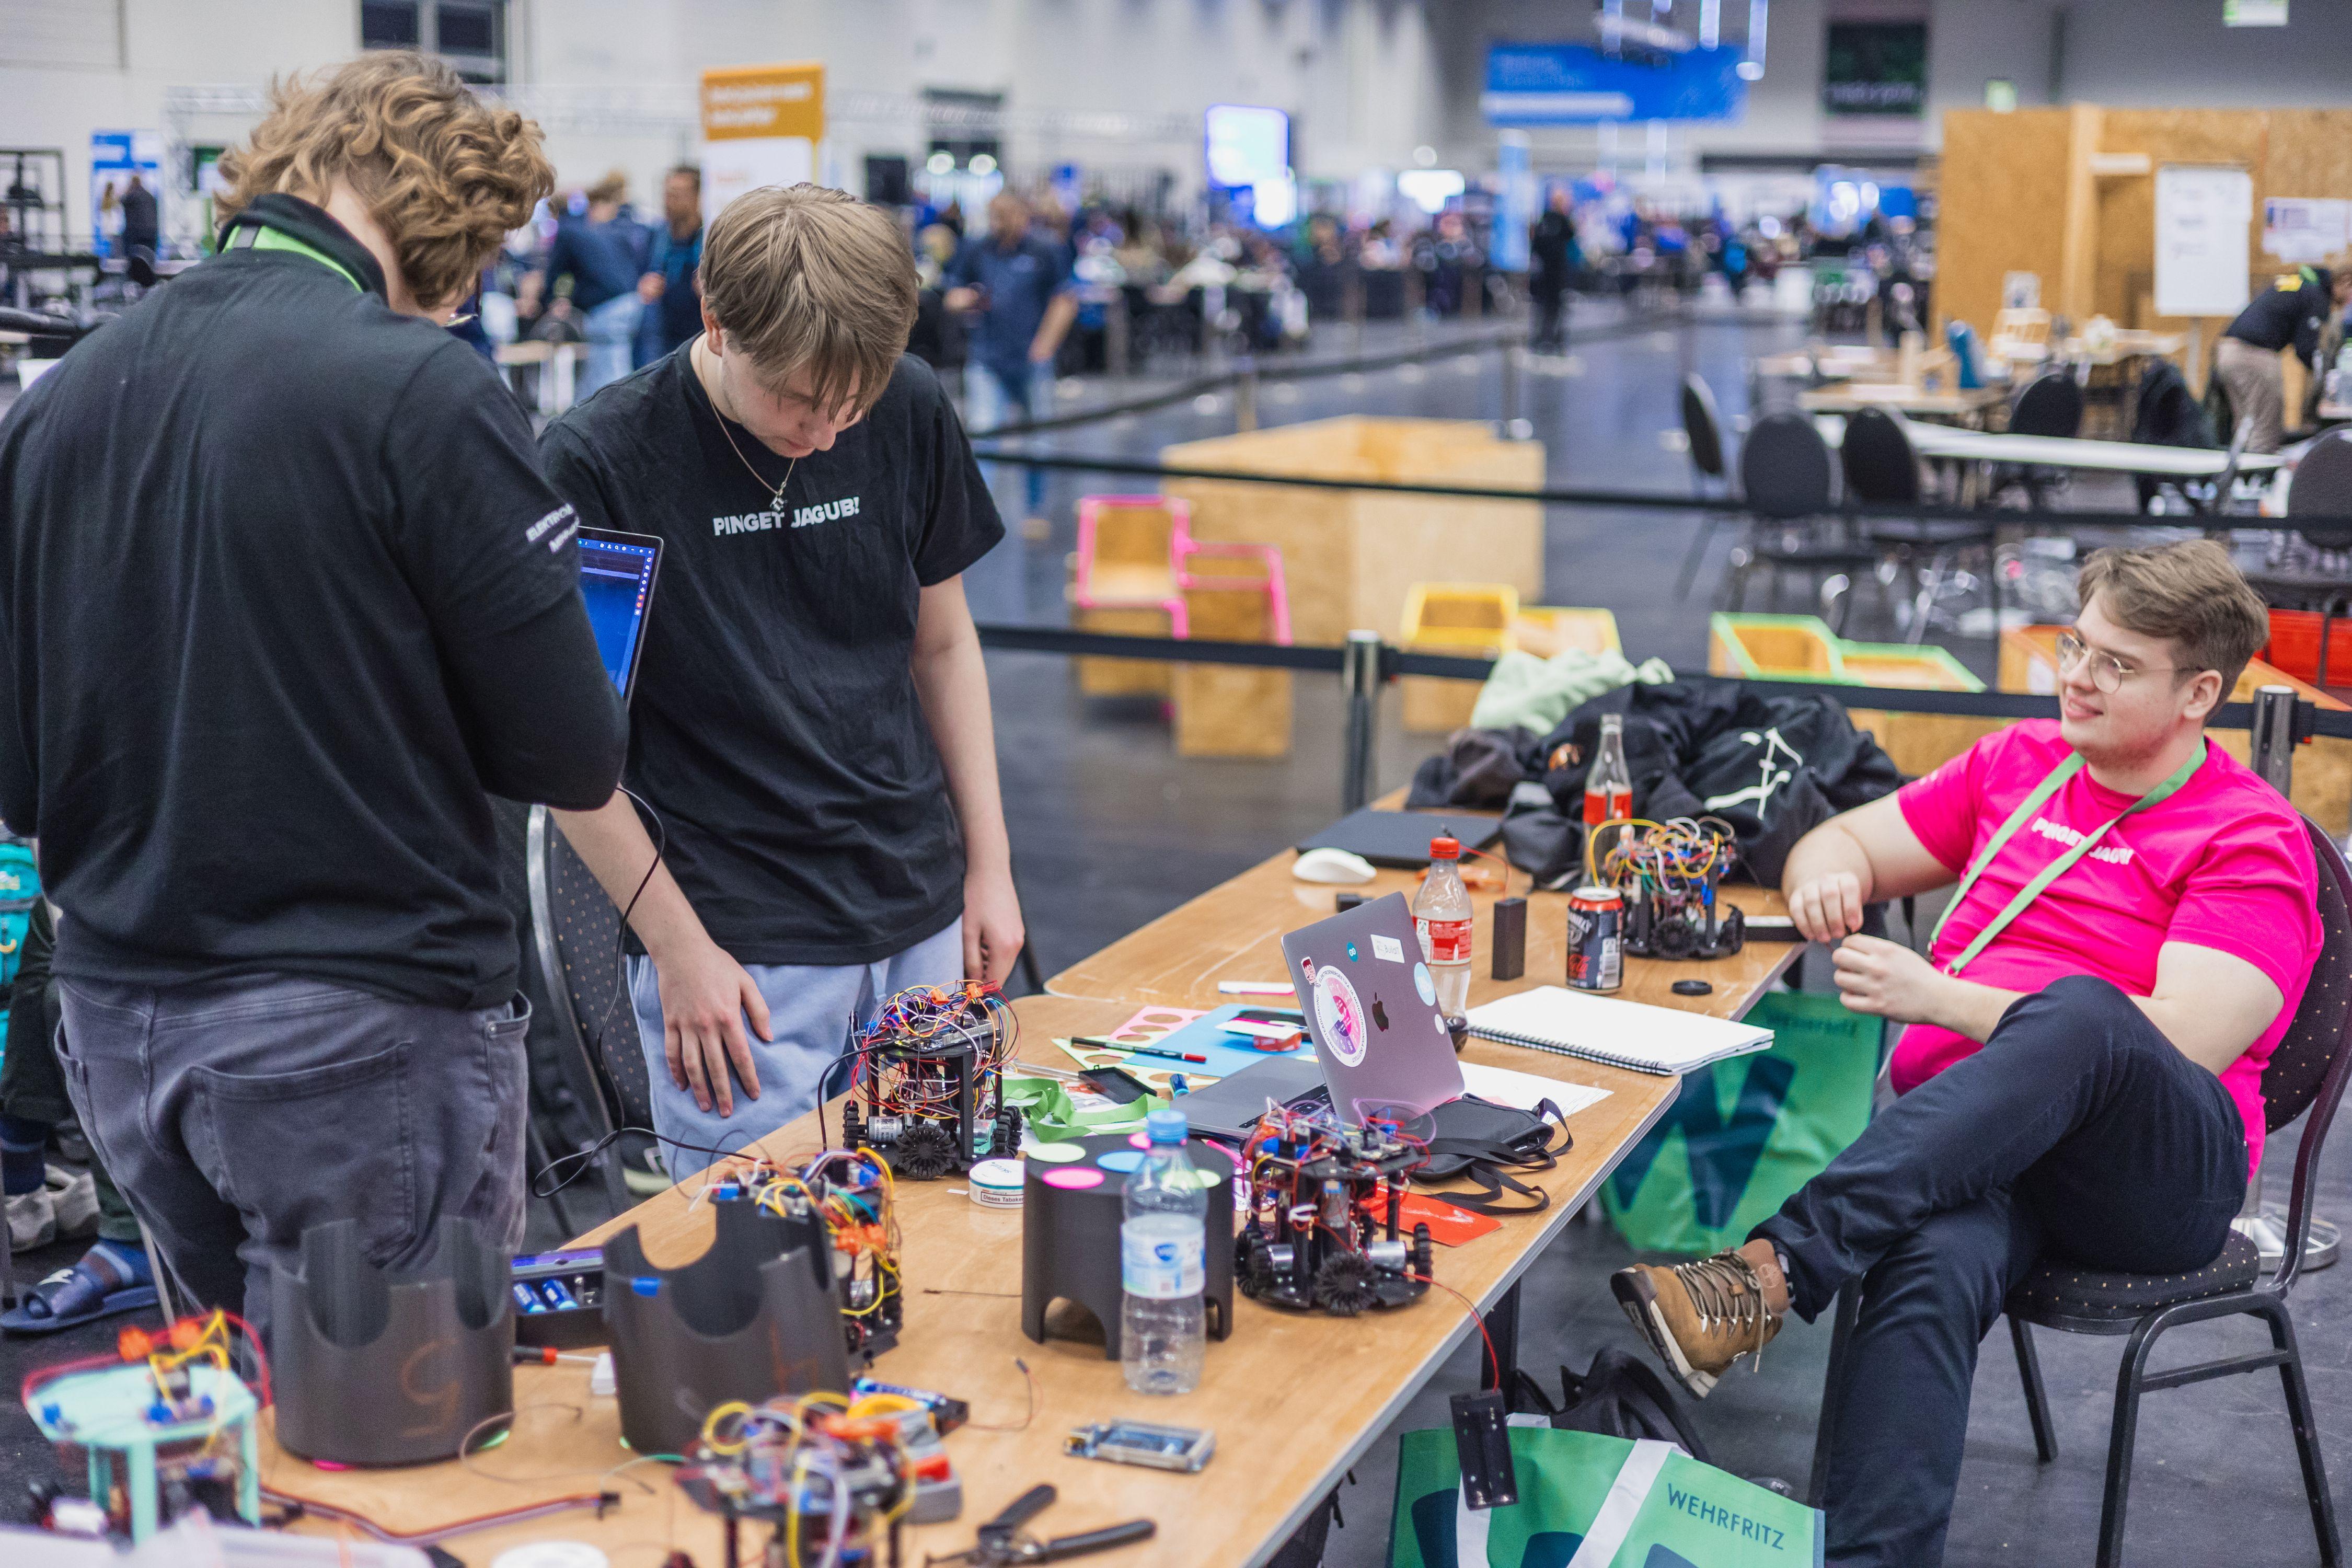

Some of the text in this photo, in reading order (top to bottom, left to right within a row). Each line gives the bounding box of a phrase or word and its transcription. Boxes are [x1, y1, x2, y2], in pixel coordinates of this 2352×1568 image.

[713, 497, 860, 536] PINGET JAGUB!
[1668, 1482, 1784, 1551] WEHRFRITZ
